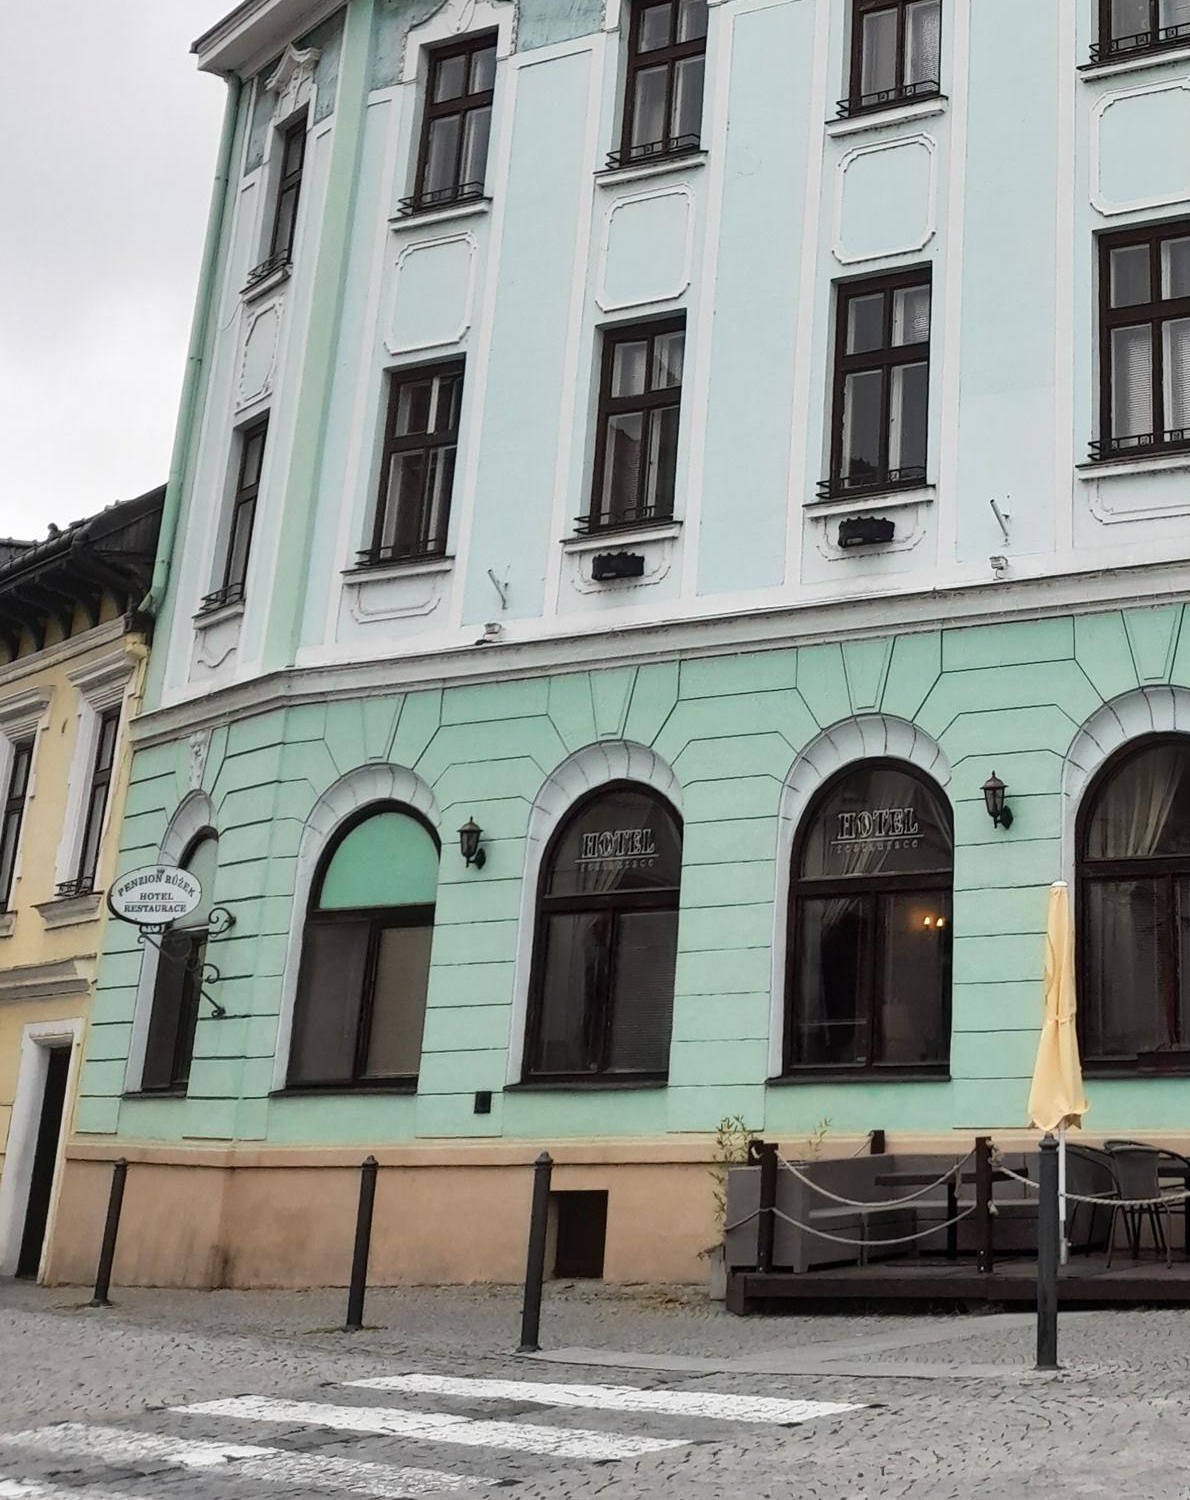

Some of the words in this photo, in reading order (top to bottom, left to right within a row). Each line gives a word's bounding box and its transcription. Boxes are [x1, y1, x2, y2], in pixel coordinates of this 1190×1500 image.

[837, 807, 919, 840] HOTEL
[581, 828, 655, 858] HOTEL
[118, 874, 163, 897] PENZION
[165, 874, 196, 898] RŮŽEK
[139, 892, 174, 901] HOTEL
[124, 904, 187, 913] RESTAURACE
